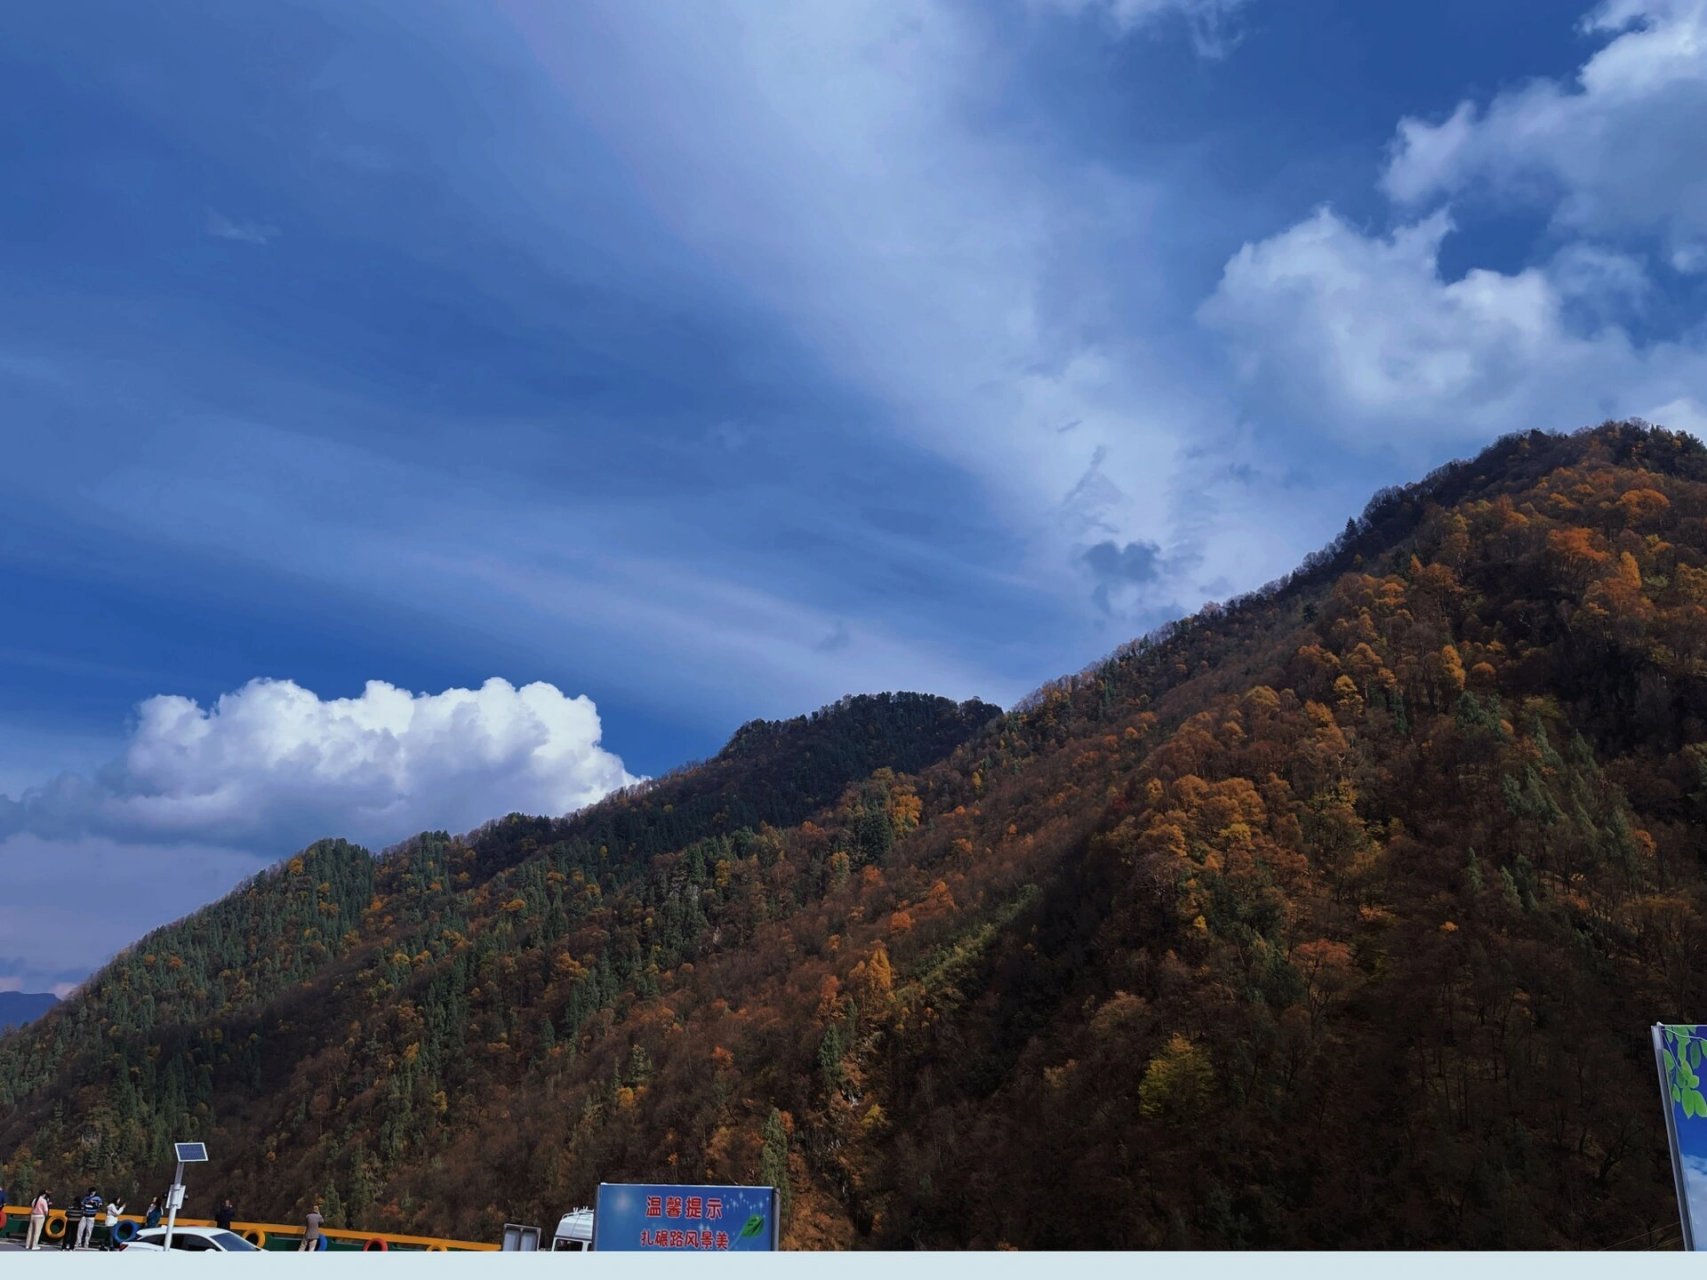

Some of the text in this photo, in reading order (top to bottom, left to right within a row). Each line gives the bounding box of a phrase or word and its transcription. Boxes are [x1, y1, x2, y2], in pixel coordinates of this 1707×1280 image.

[646, 1196, 723, 1219] 温馨提示
[641, 1230, 729, 1249] 扎碾路风景美
